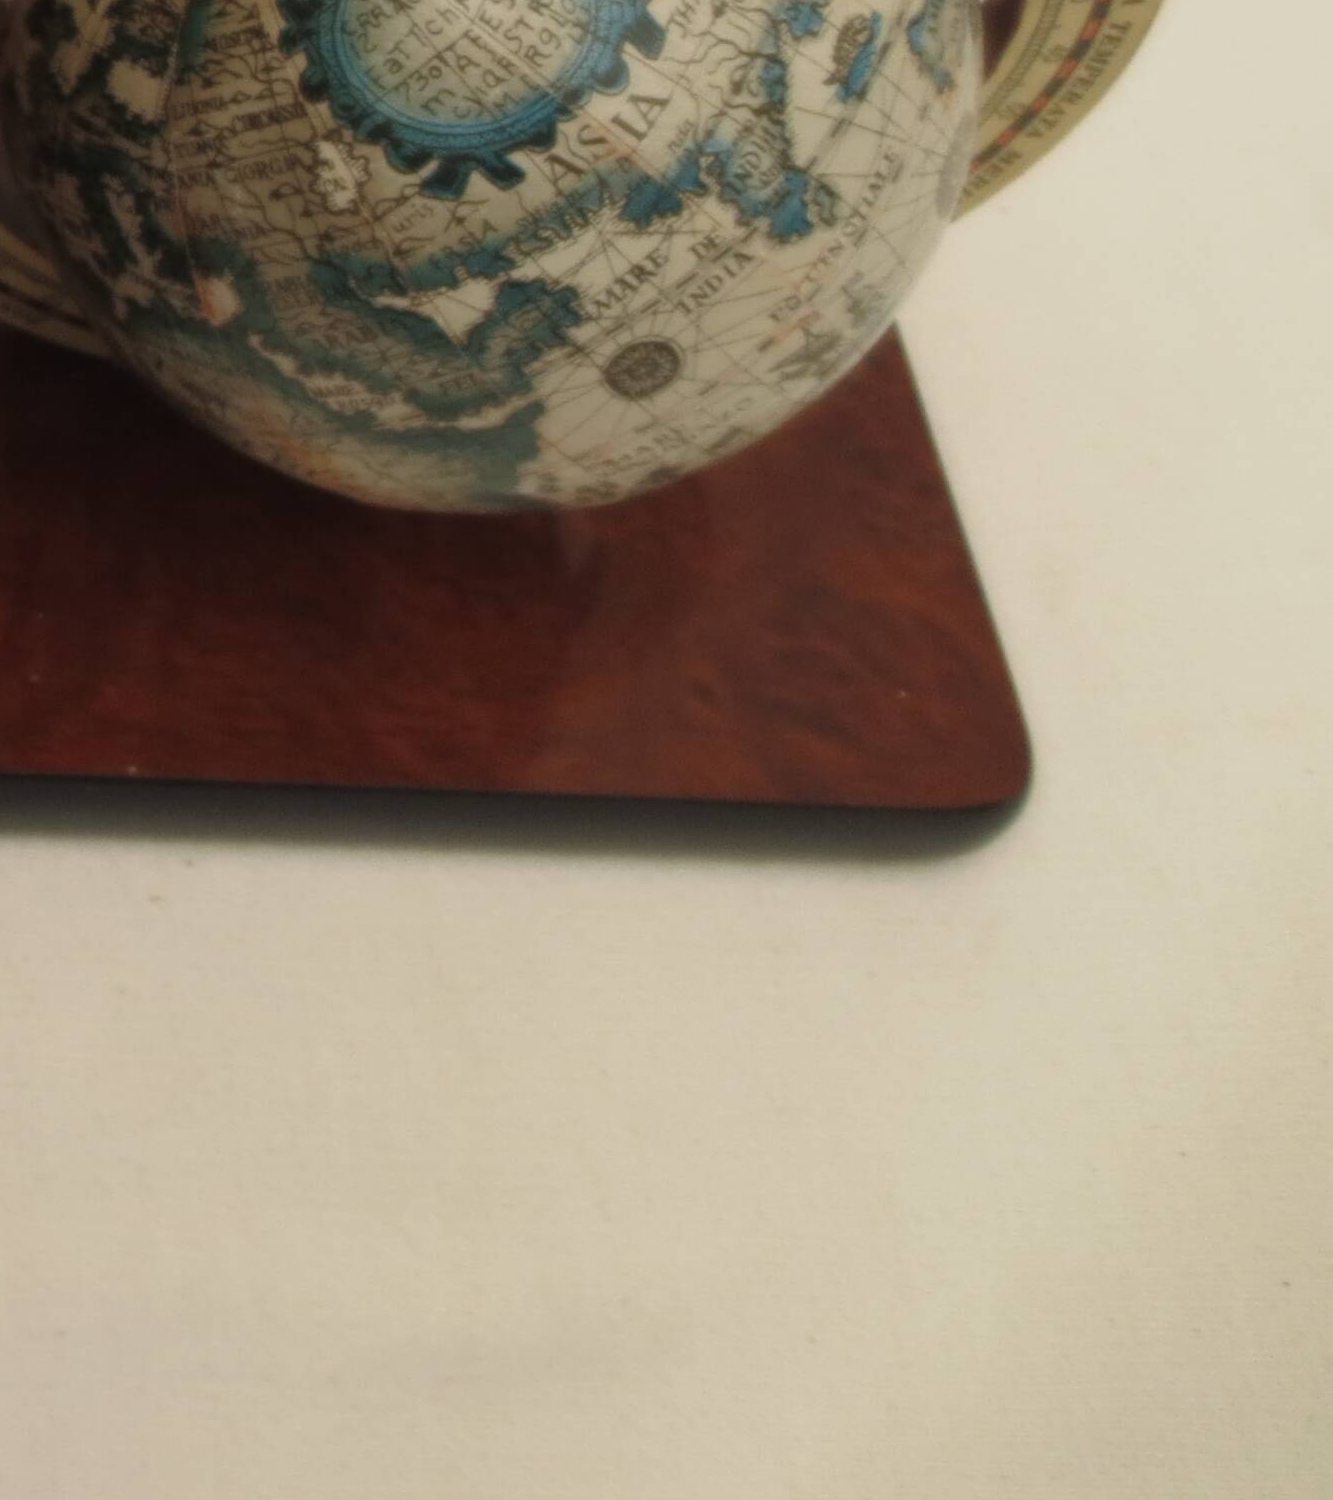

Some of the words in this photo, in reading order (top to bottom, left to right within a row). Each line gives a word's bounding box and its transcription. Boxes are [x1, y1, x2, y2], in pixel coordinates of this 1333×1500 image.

[592, 245, 670, 315] MARE
[674, 245, 755, 317] INDIA
[688, 232, 729, 262] DE
